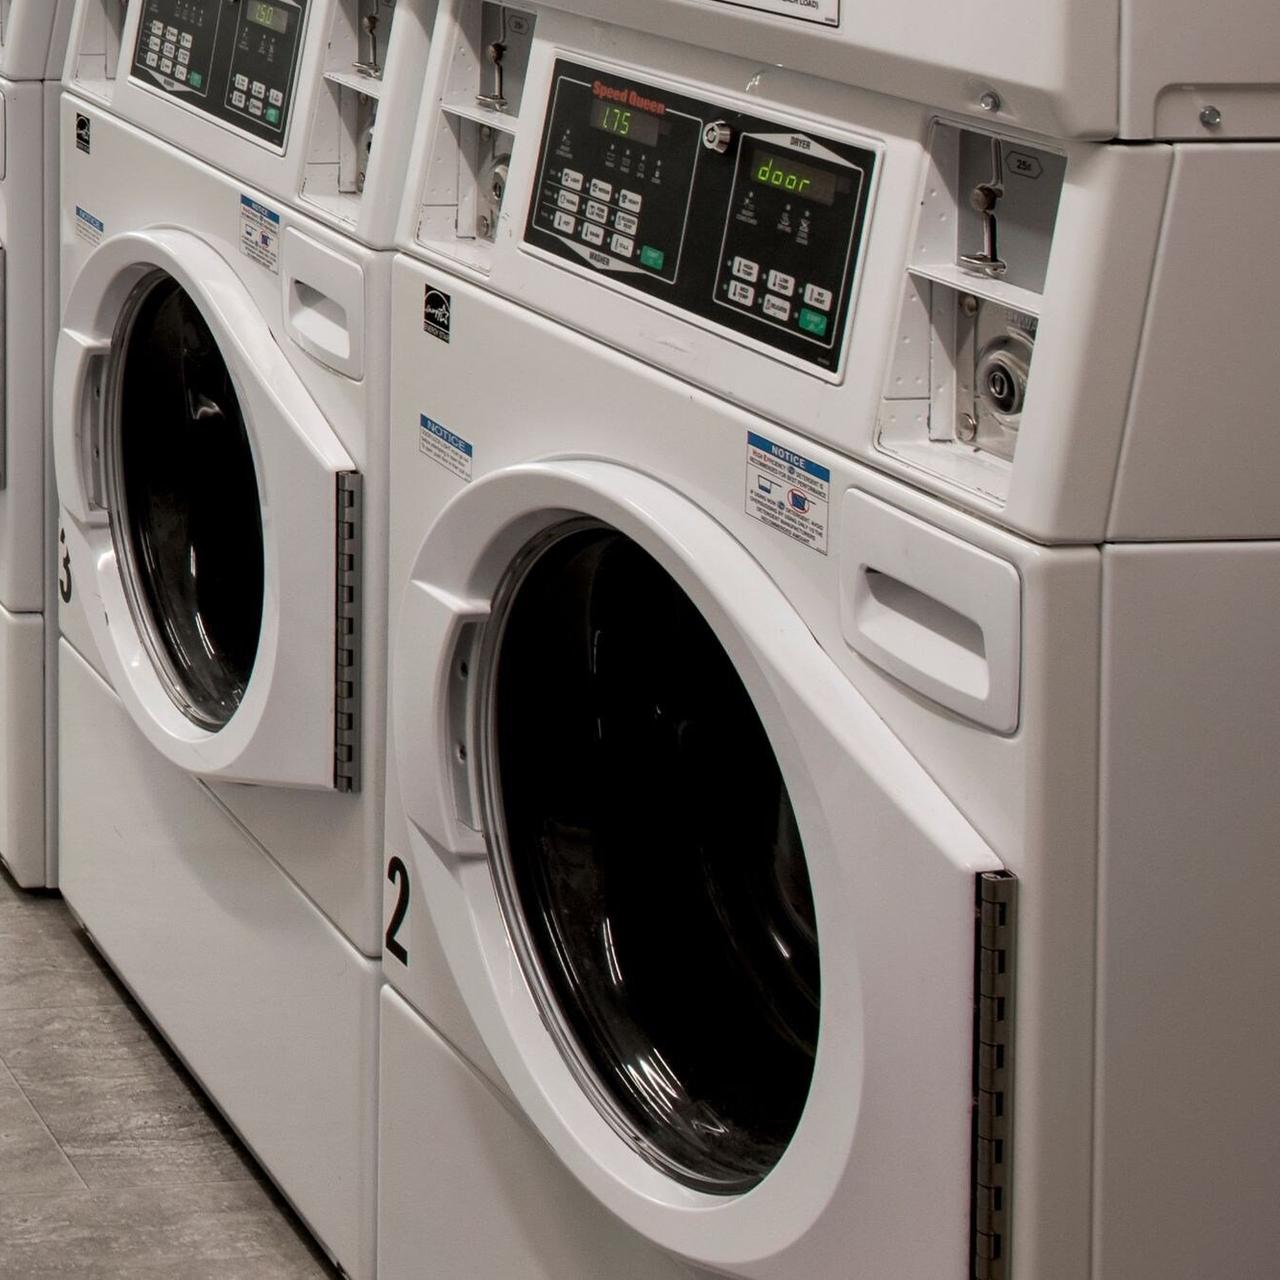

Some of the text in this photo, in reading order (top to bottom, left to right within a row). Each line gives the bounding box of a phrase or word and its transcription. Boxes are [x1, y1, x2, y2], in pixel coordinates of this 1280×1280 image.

[592, 80, 666, 114] Speed Queen
[758, 158, 810, 192] door
[427, 420, 468, 452] NOTICE
[772, 444, 806, 470] NOTICE
[59, 528, 72, 604] 3
[386, 855, 411, 966] 2
